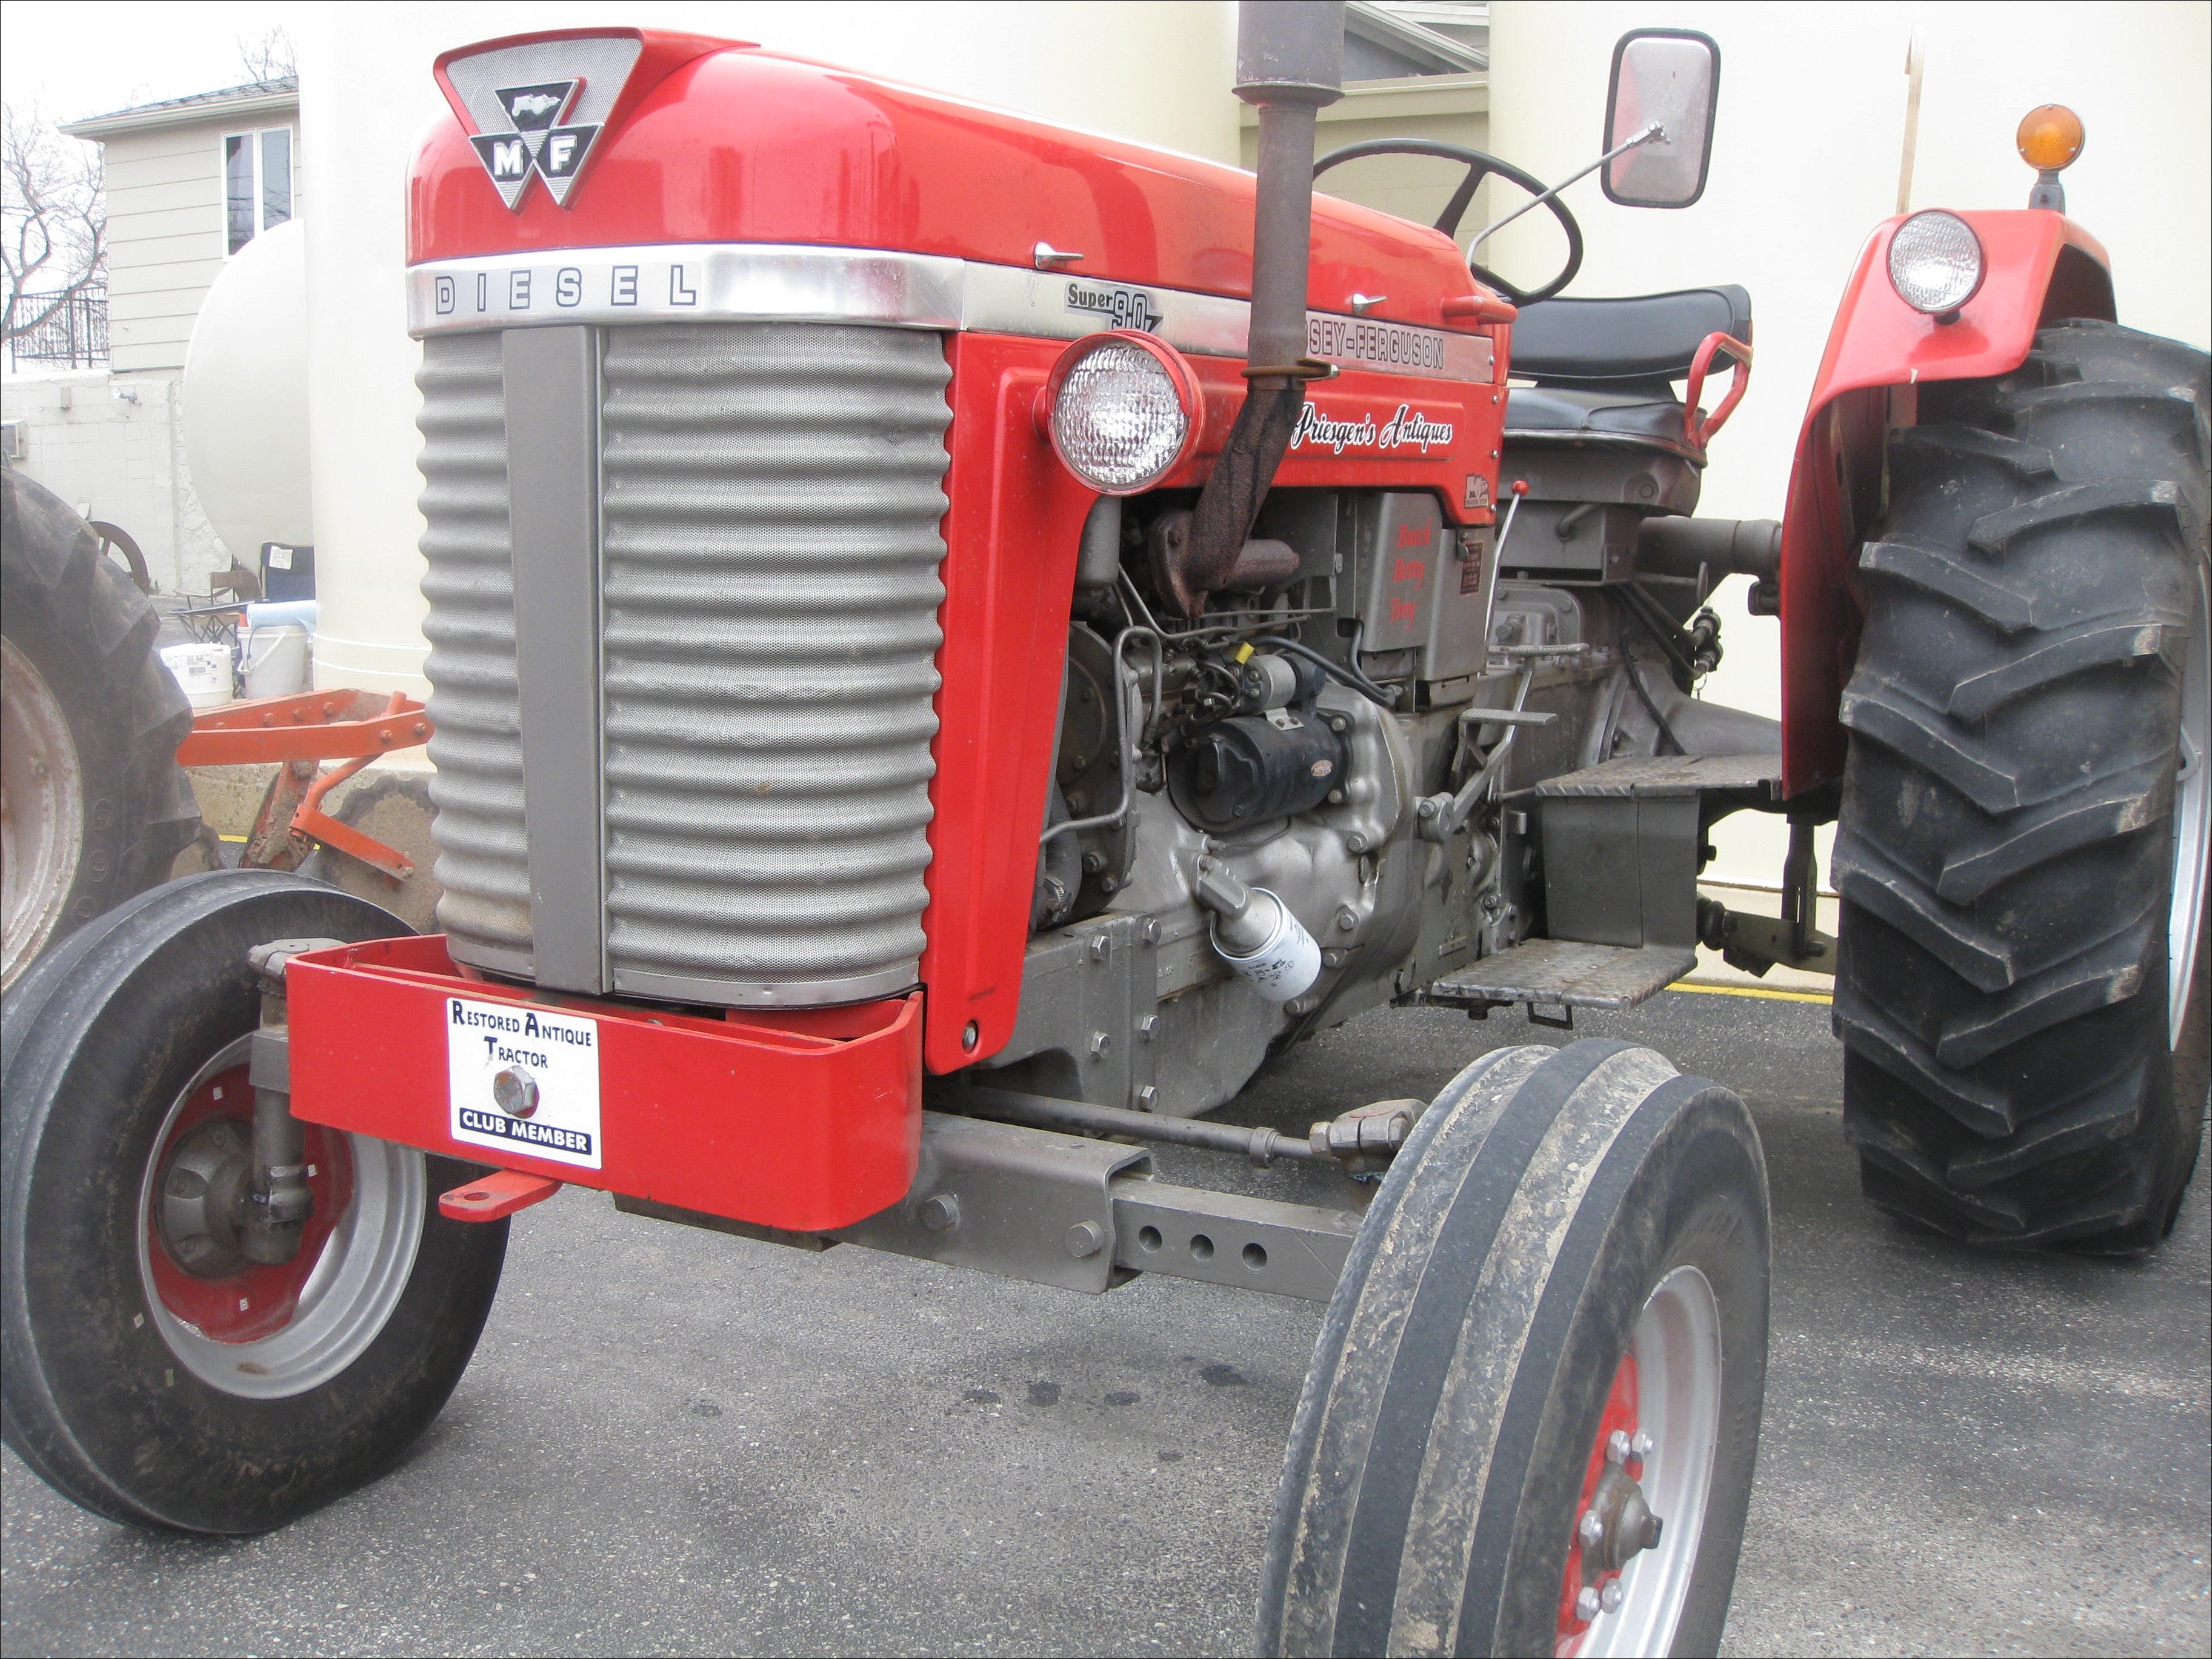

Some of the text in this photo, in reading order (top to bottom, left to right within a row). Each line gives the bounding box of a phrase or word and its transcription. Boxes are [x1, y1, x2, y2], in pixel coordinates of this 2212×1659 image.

[435, 265, 696, 314] DIESEL
[1067, 283, 1147, 330] Super 90
[1306, 319, 1444, 369] SEY-FERGUSON
[1291, 402, 1452, 453] Priesgen's Antiques
[452, 1000, 591, 1046] RESTORED ANTIQUE
[484, 1036, 548, 1068] TRACTOR
[462, 1111, 588, 1151] CLUB MEMBER
